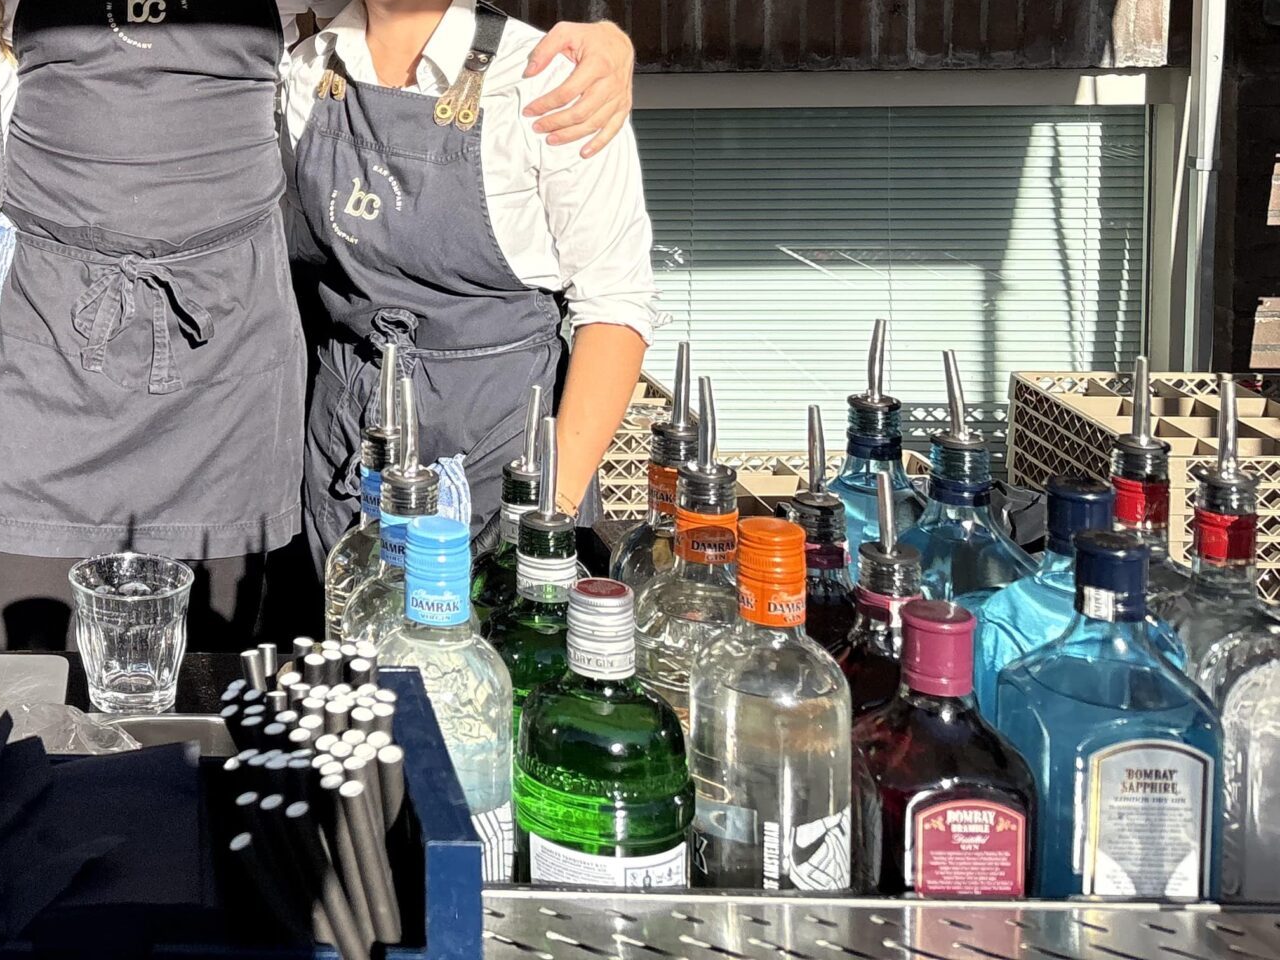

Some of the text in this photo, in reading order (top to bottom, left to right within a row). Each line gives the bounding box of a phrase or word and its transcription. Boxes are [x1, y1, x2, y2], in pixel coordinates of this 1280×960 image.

[343, 176, 382, 221] bc
[411, 596, 461, 613] DAMRAK
[573, 652, 592, 665] DRY
[595, 658, 615, 668] GIN
[945, 809, 997, 826] BOMBAY
[950, 823, 991, 834] BRAMBLE
